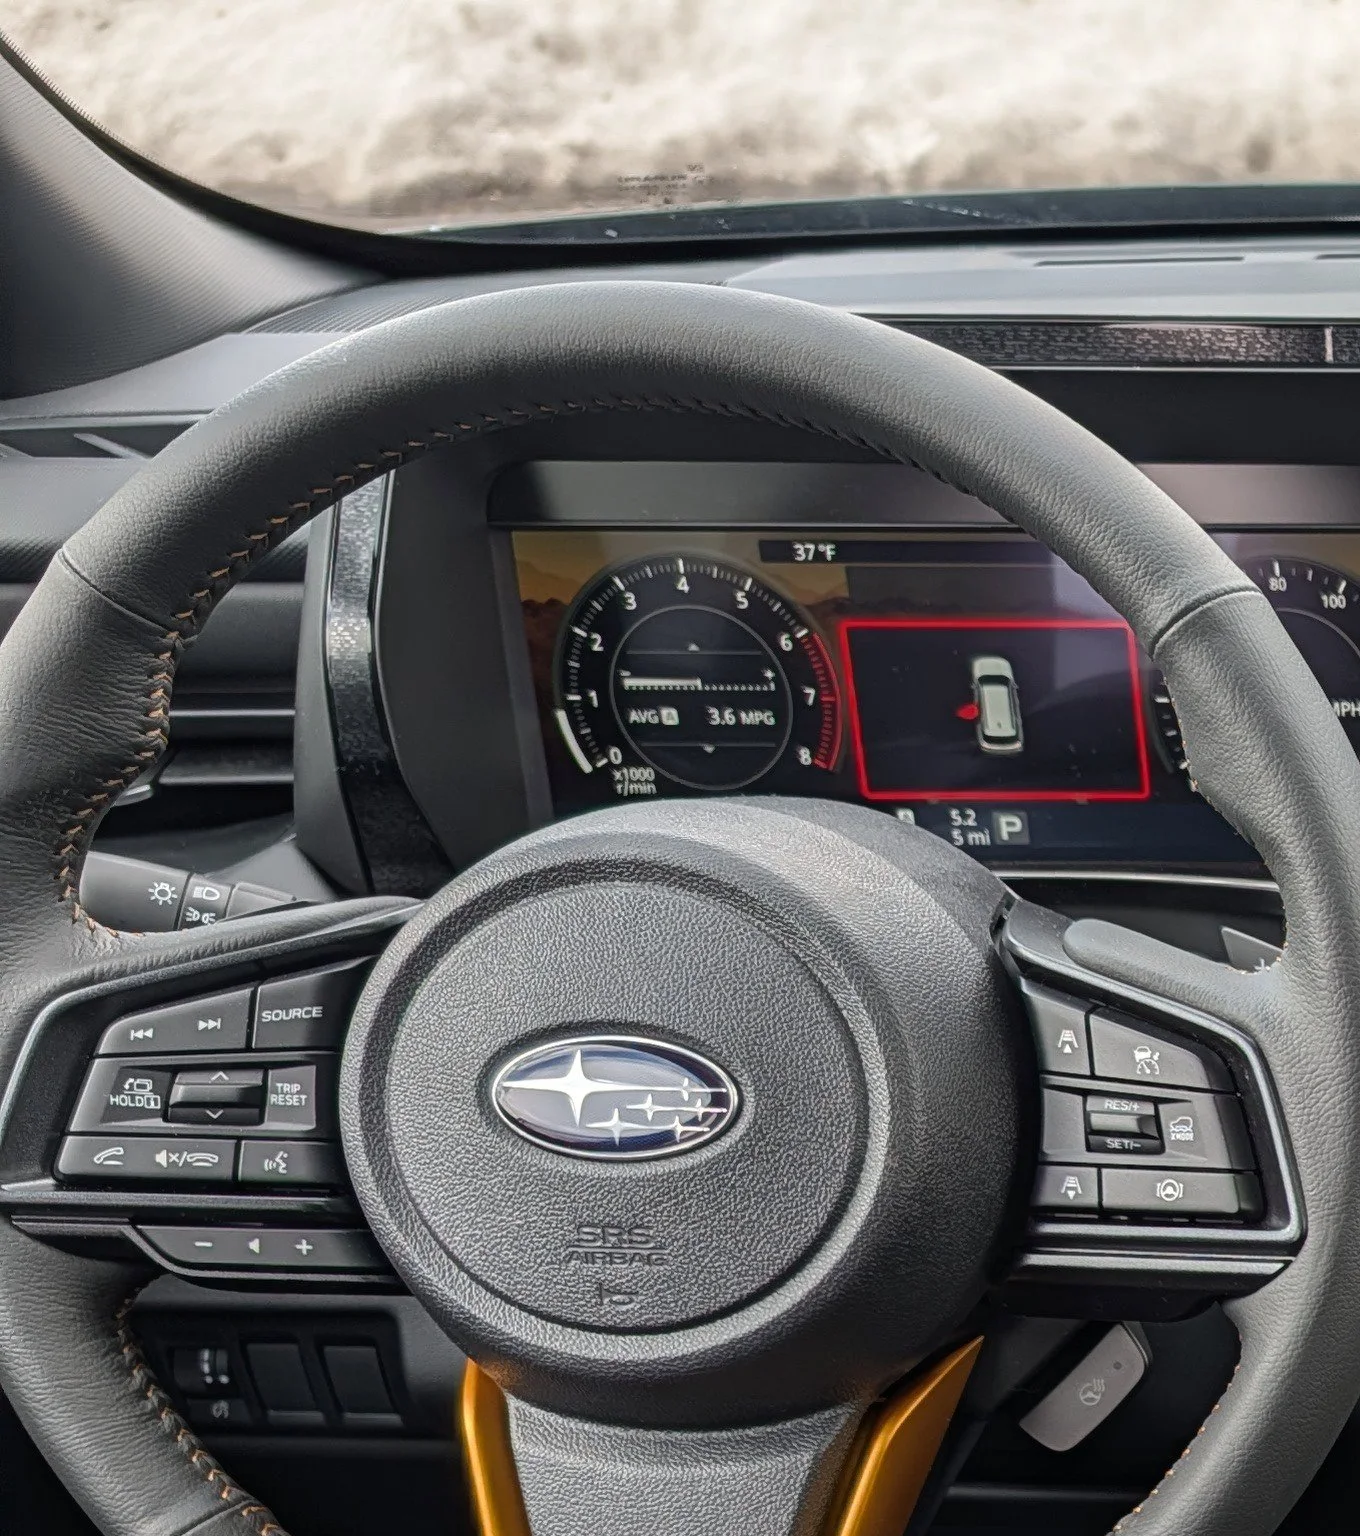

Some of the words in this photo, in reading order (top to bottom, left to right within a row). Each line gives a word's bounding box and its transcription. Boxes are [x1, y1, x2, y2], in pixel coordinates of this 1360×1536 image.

[676, 577, 689, 594] 4
[1269, 577, 1287, 592] 80
[624, 593, 637, 610] 3
[736, 593, 749, 610] 5
[1320, 594, 1347, 610] 100
[590, 635, 604, 652] 2
[778, 634, 794, 651] 6
[587, 690, 599, 707] 1
[804, 689, 816, 706] 7
[628, 708, 660, 725] AVG
[707, 706, 736, 726] 3.6
[739, 710, 776, 726] MPG
[608, 747, 622, 765] 0
[799, 749, 812, 766] 8
[615, 779, 657, 796] r/min
[999, 814, 1023, 841] P
[967, 827, 991, 846] mi
[261, 1006, 323, 1024] SOURCE
[276, 1083, 301, 1094] TRIP
[110, 1094, 144, 1107] HOLD
[270, 1093, 308, 1106] RESET
[574, 1224, 656, 1248] SRS
[563, 1251, 670, 1267] AIRBAG
